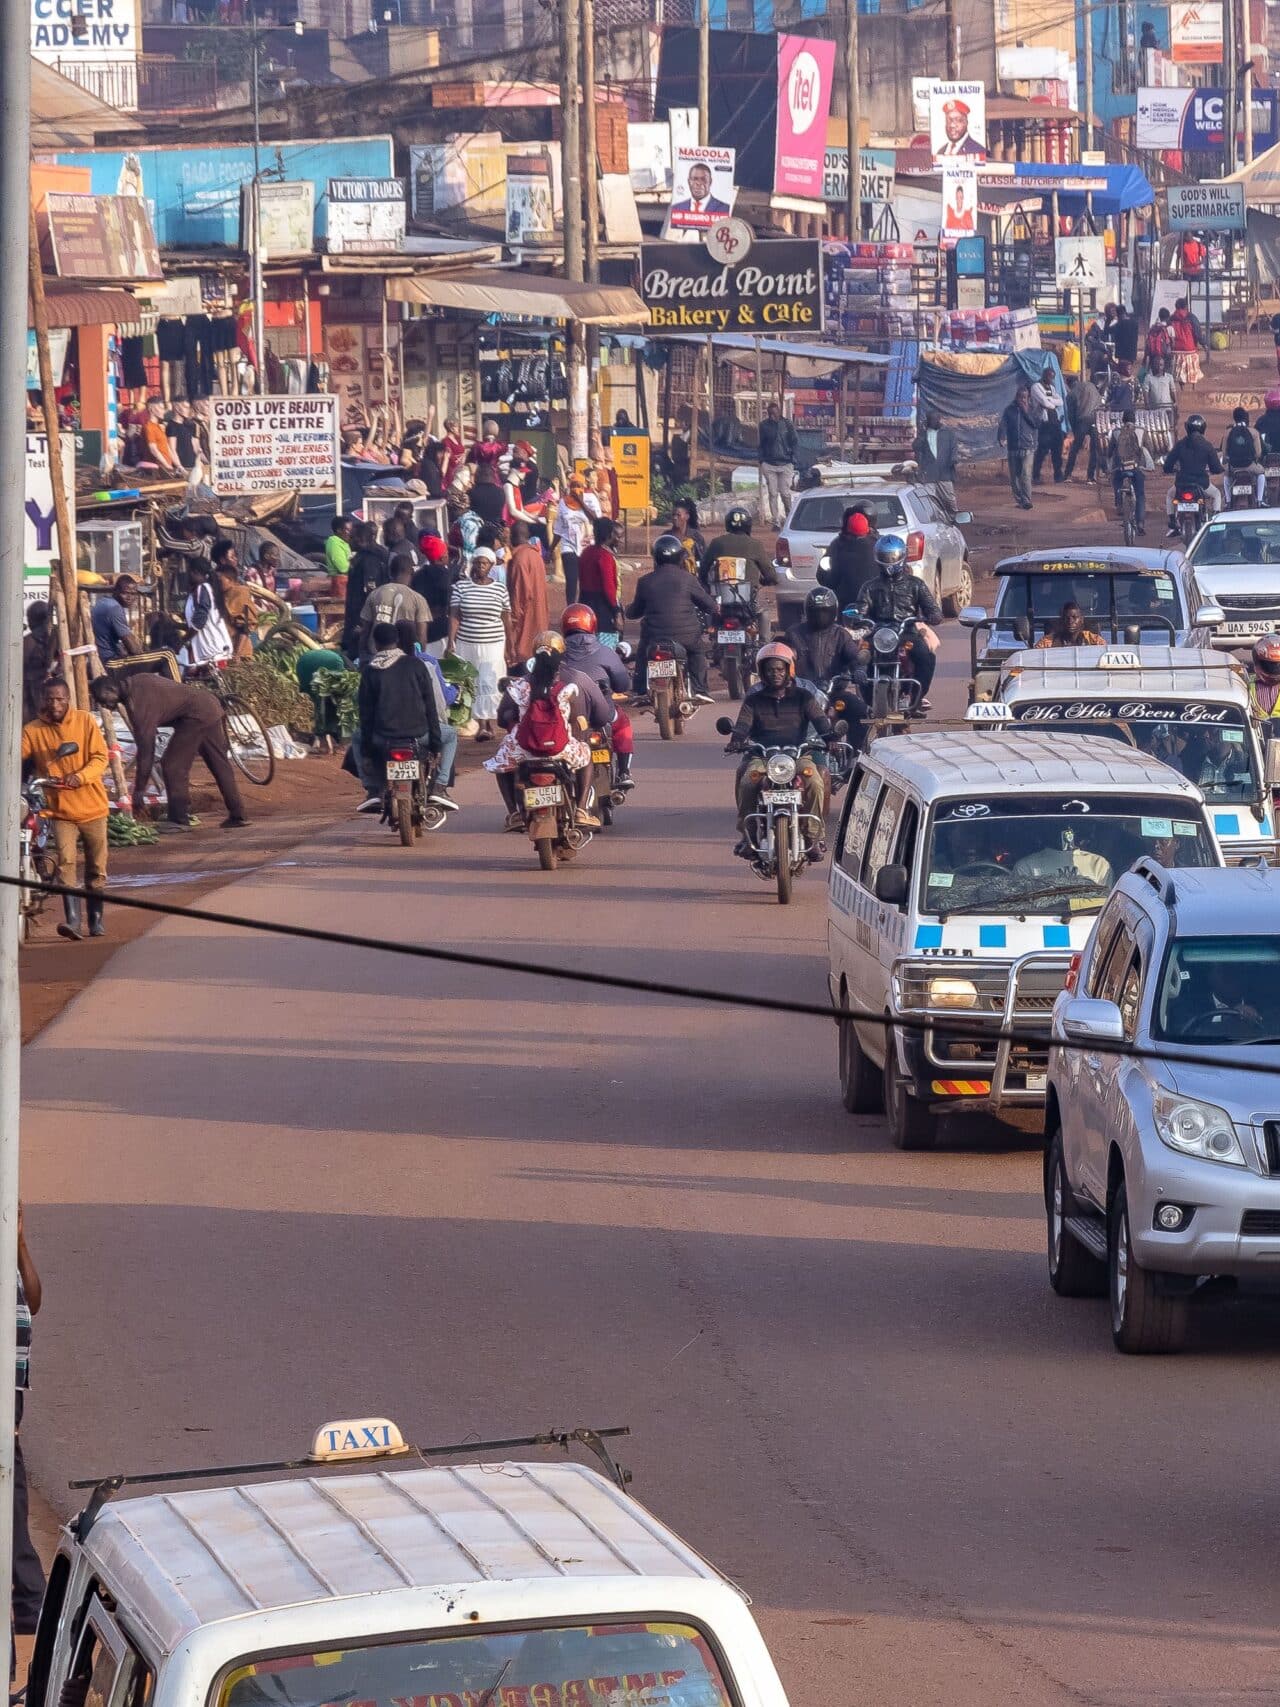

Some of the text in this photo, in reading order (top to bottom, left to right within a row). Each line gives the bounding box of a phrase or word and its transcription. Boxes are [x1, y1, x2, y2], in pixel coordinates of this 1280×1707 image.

[35, 0, 113, 18] CCER
[35, 24, 129, 46] ADMY
[793, 71, 815, 111] itel
[824, 153, 848, 170] OD'S
[859, 153, 877, 170] ILL
[979, 176, 1018, 186] CLASSIC
[332, 181, 403, 199] VICTORY TRADERS
[1181, 188, 1231, 201] GOD'S WILL
[1172, 202, 1240, 218] SUPERMARKET
[644, 264, 817, 299] Bread Point
[649, 302, 813, 331] Bakery & Cafe
[256, 401, 286, 415] LOVE
[289, 400, 334, 414] BEAUTY
[216, 417, 324, 431] & GIFT CENTRE
[221, 434, 272, 445] KIDS TOYS
[222, 447, 243, 456] BODY
[29, 459, 45, 468] Test
[298, 455, 333, 465] SCRUBS
[1227, 623, 1270, 632] UAX 594S
[1105, 654, 1135, 665] TAXI
[972, 705, 1007, 717] TAXI
[1021, 703, 1226, 722] He Has Been God
[398, 761, 416, 770] UGC
[394, 770, 417, 779] 271X
[324, 1426, 390, 1451] TAXI
